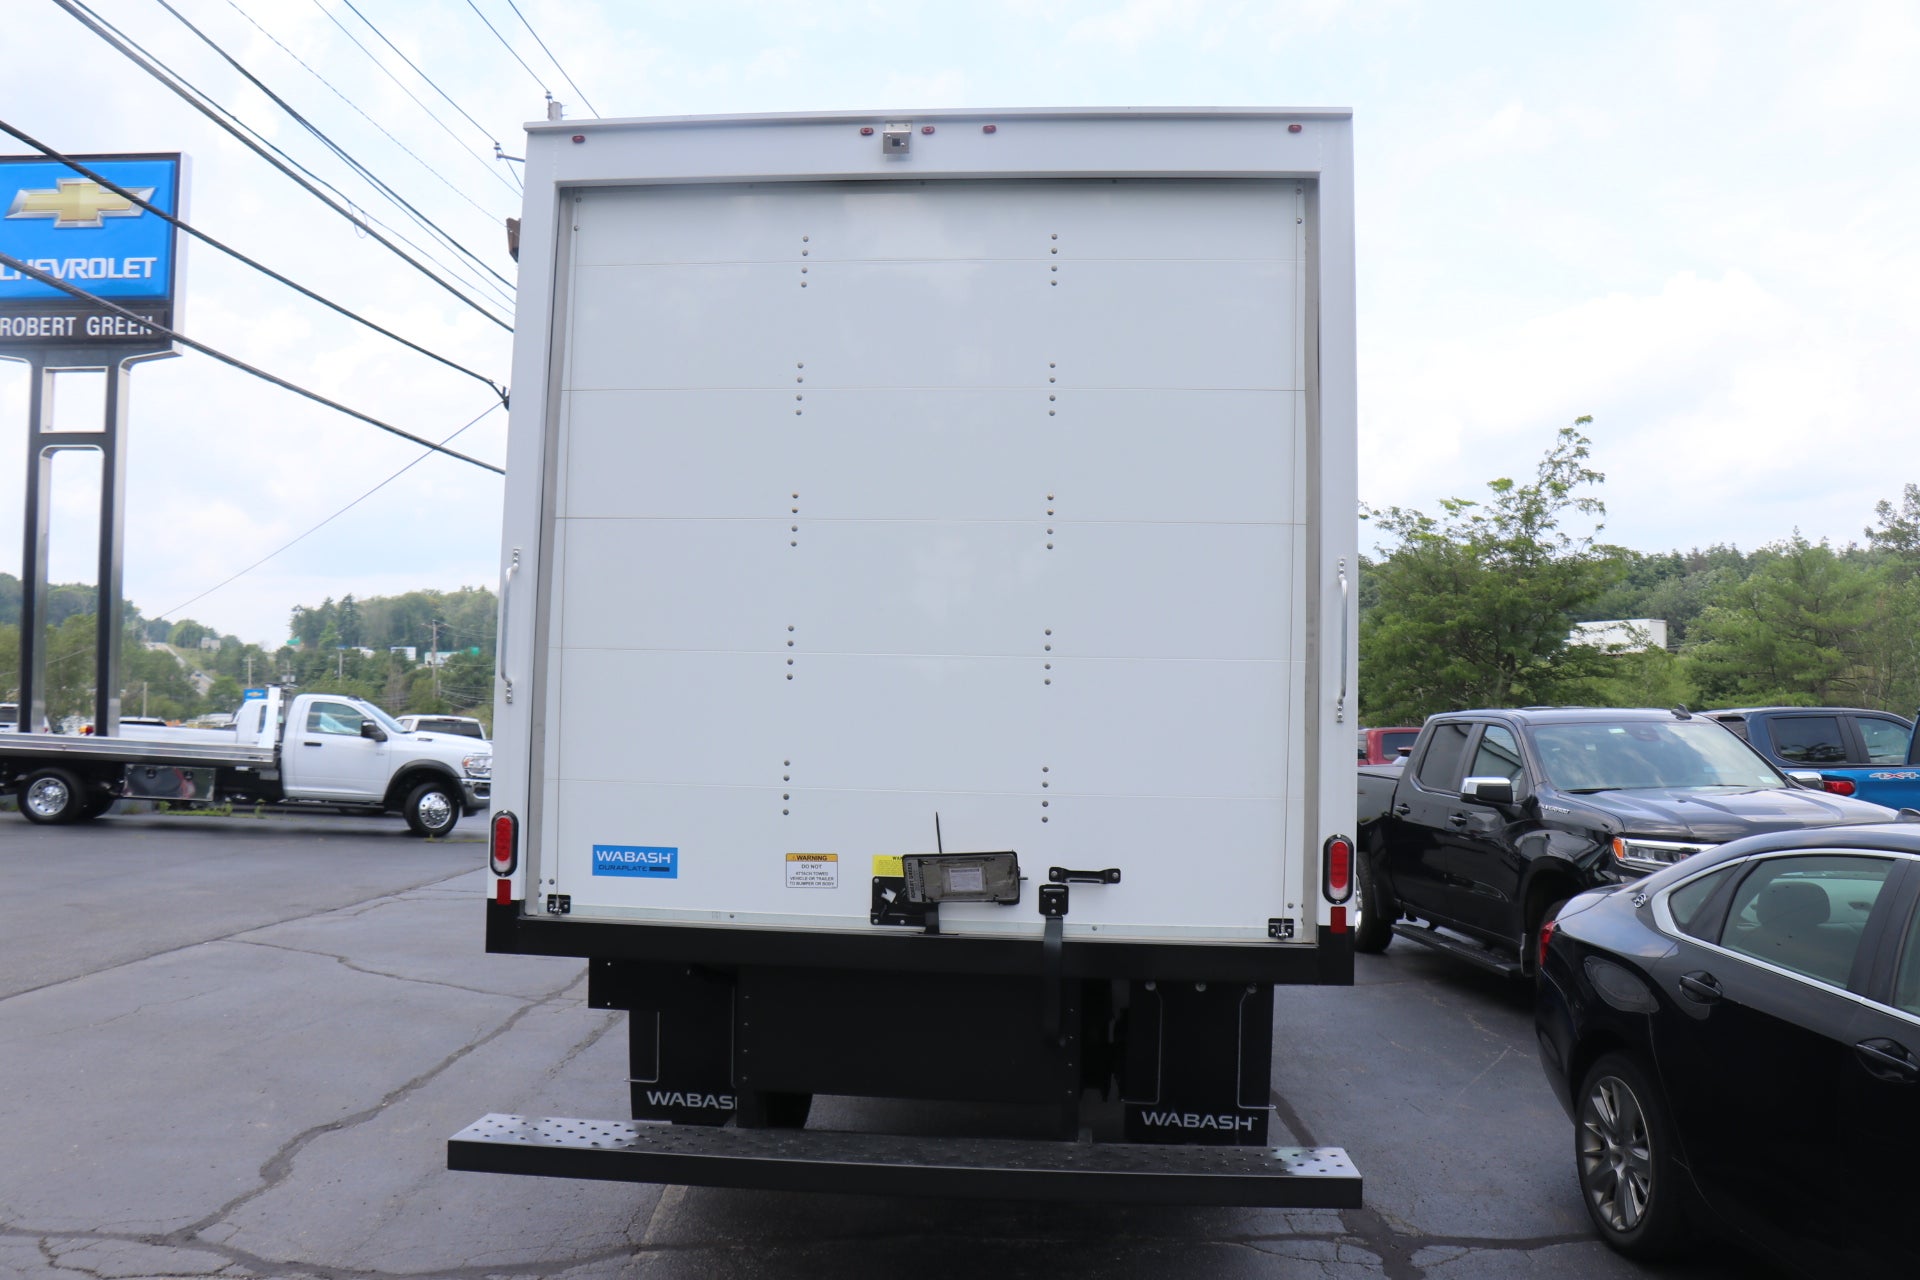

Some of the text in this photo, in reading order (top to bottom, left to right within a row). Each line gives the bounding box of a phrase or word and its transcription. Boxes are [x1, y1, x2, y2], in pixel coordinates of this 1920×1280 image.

[0, 315, 153, 337] ROBERT GREEN
[596, 850, 671, 864] WABASH
[598, 864, 648, 872] DURAPLATE
[1141, 1111, 1253, 1131] WABASH
